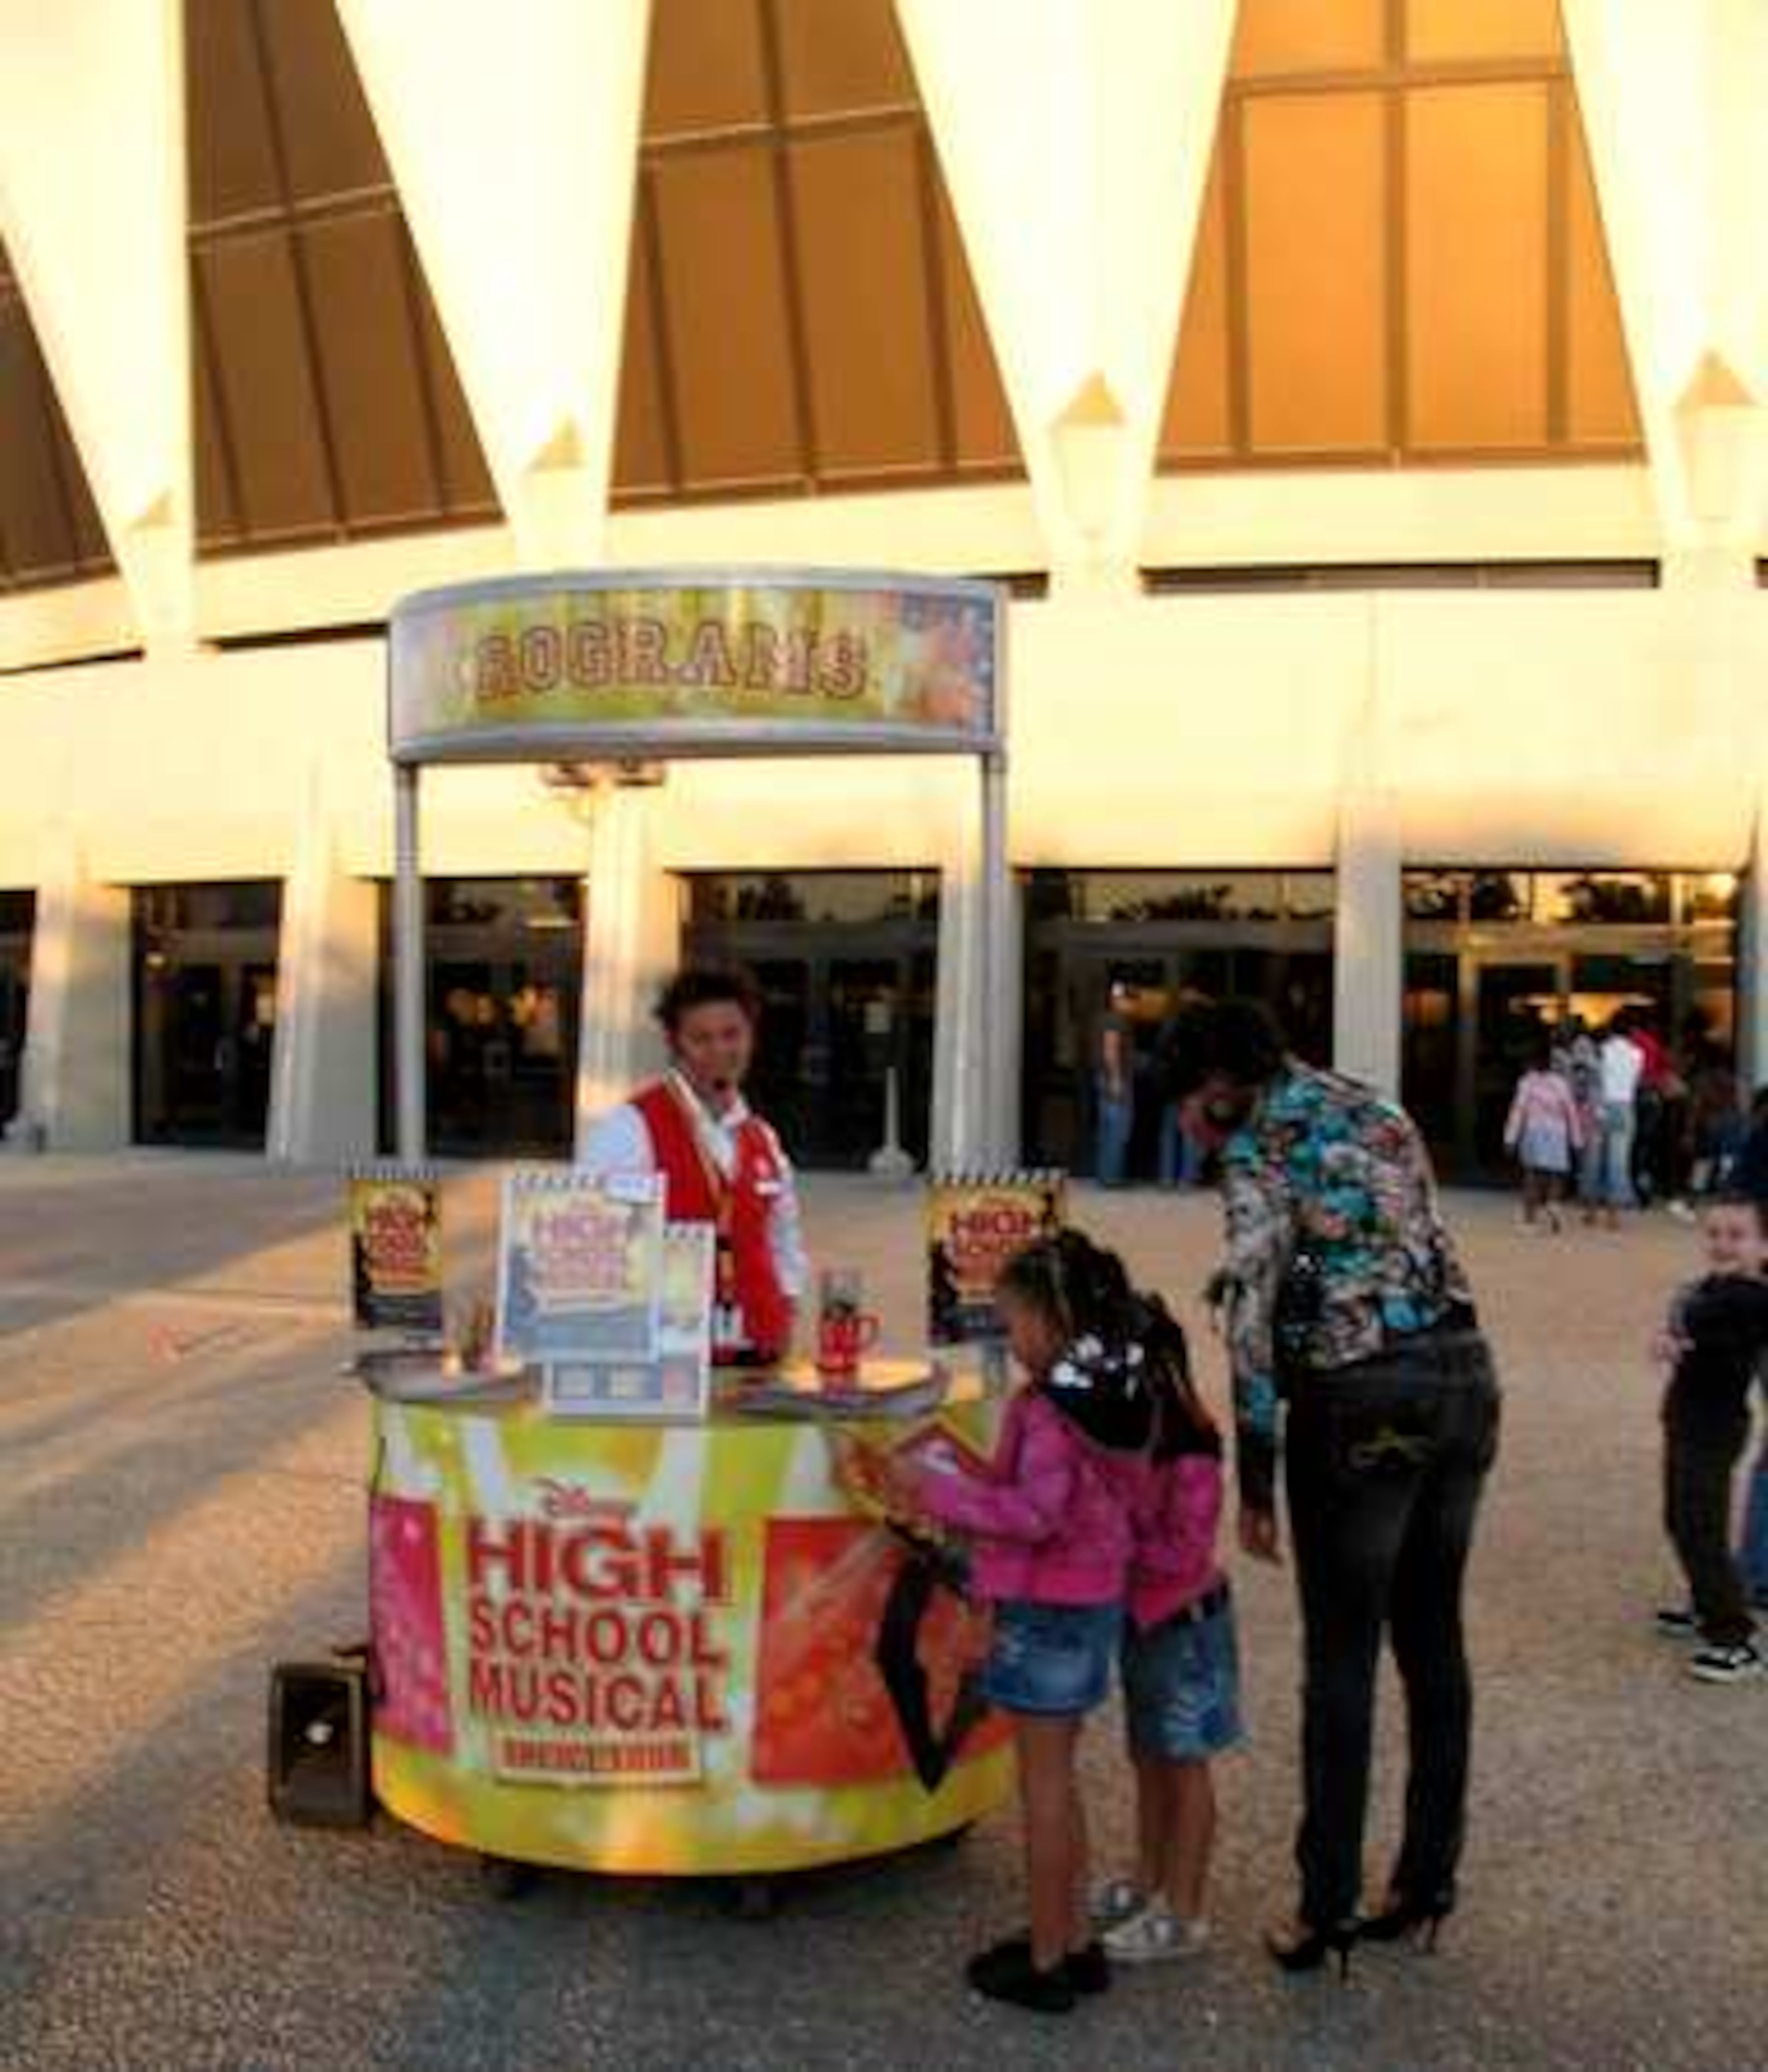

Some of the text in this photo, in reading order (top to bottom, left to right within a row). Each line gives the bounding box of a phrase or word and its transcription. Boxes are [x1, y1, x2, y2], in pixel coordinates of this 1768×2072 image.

[450, 616, 867, 699] ROGRAMS
[467, 1518, 731, 1602] HIGH
[471, 1597, 728, 1668] SCHOOL
[470, 1659, 731, 1732] MUSICAL
